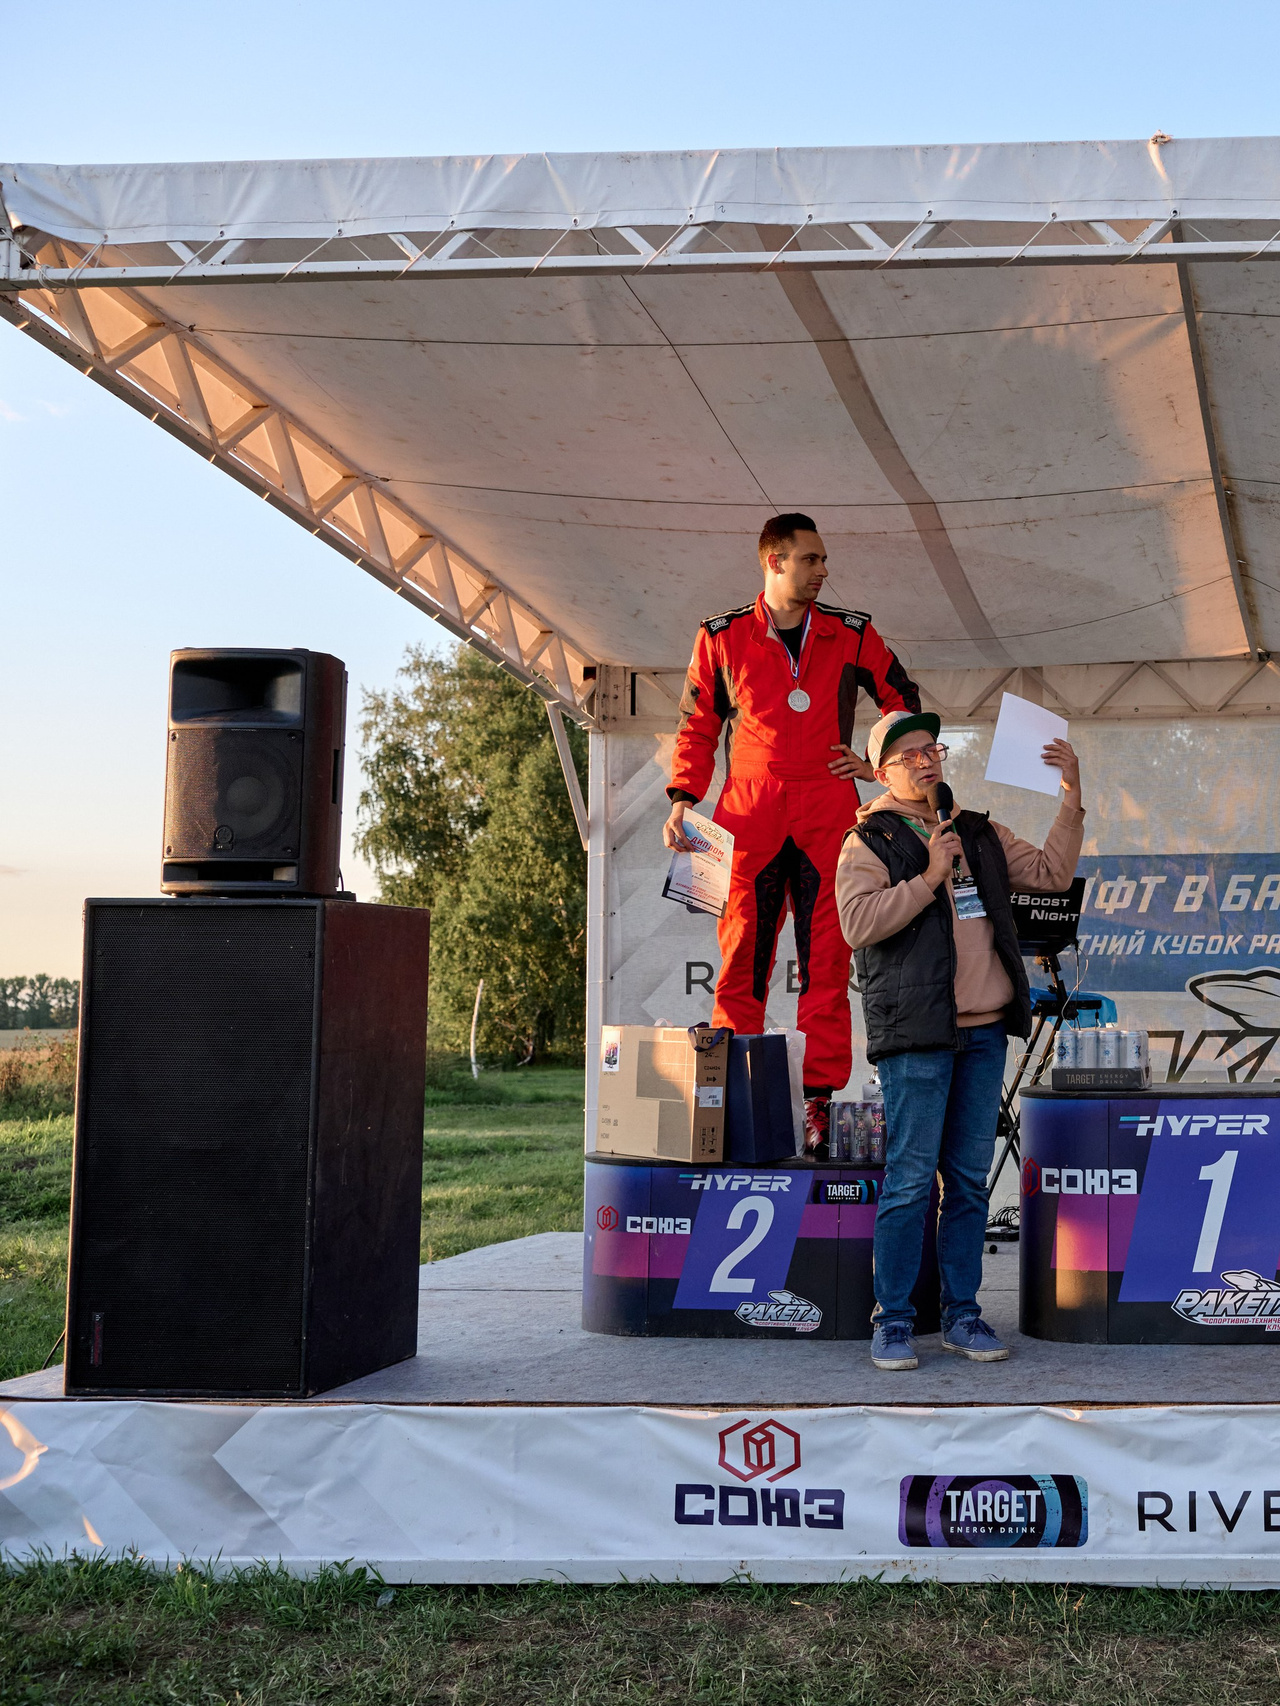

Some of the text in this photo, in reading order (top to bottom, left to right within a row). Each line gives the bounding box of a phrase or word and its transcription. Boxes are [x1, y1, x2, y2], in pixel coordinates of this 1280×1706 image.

[710, 618, 728, 630] OMP
[845, 616, 863, 628] OMP
[691, 836, 724, 857] ДИПЛОМ
[1173, 875, 1209, 913] В
[1152, 934, 1244, 955] КУБОК
[1066, 1074, 1095, 1084] TARGET
[1136, 1115, 1270, 1136] HYPER
[690, 1174, 792, 1191] HYPER
[826, 1184, 861, 1196] TARGET
[1041, 1168, 1138, 1194] СОЮЗ
[1193, 1151, 1238, 1273] 1
[627, 1216, 691, 1234] СОЮЗ
[709, 1195, 774, 1293] 2
[737, 1303, 820, 1321] РАКЕТА
[674, 1483, 844, 1530] СОЮЗ
[945, 1490, 1041, 1523] TARGET
[949, 1526, 1036, 1535] ENERGY DRINK
